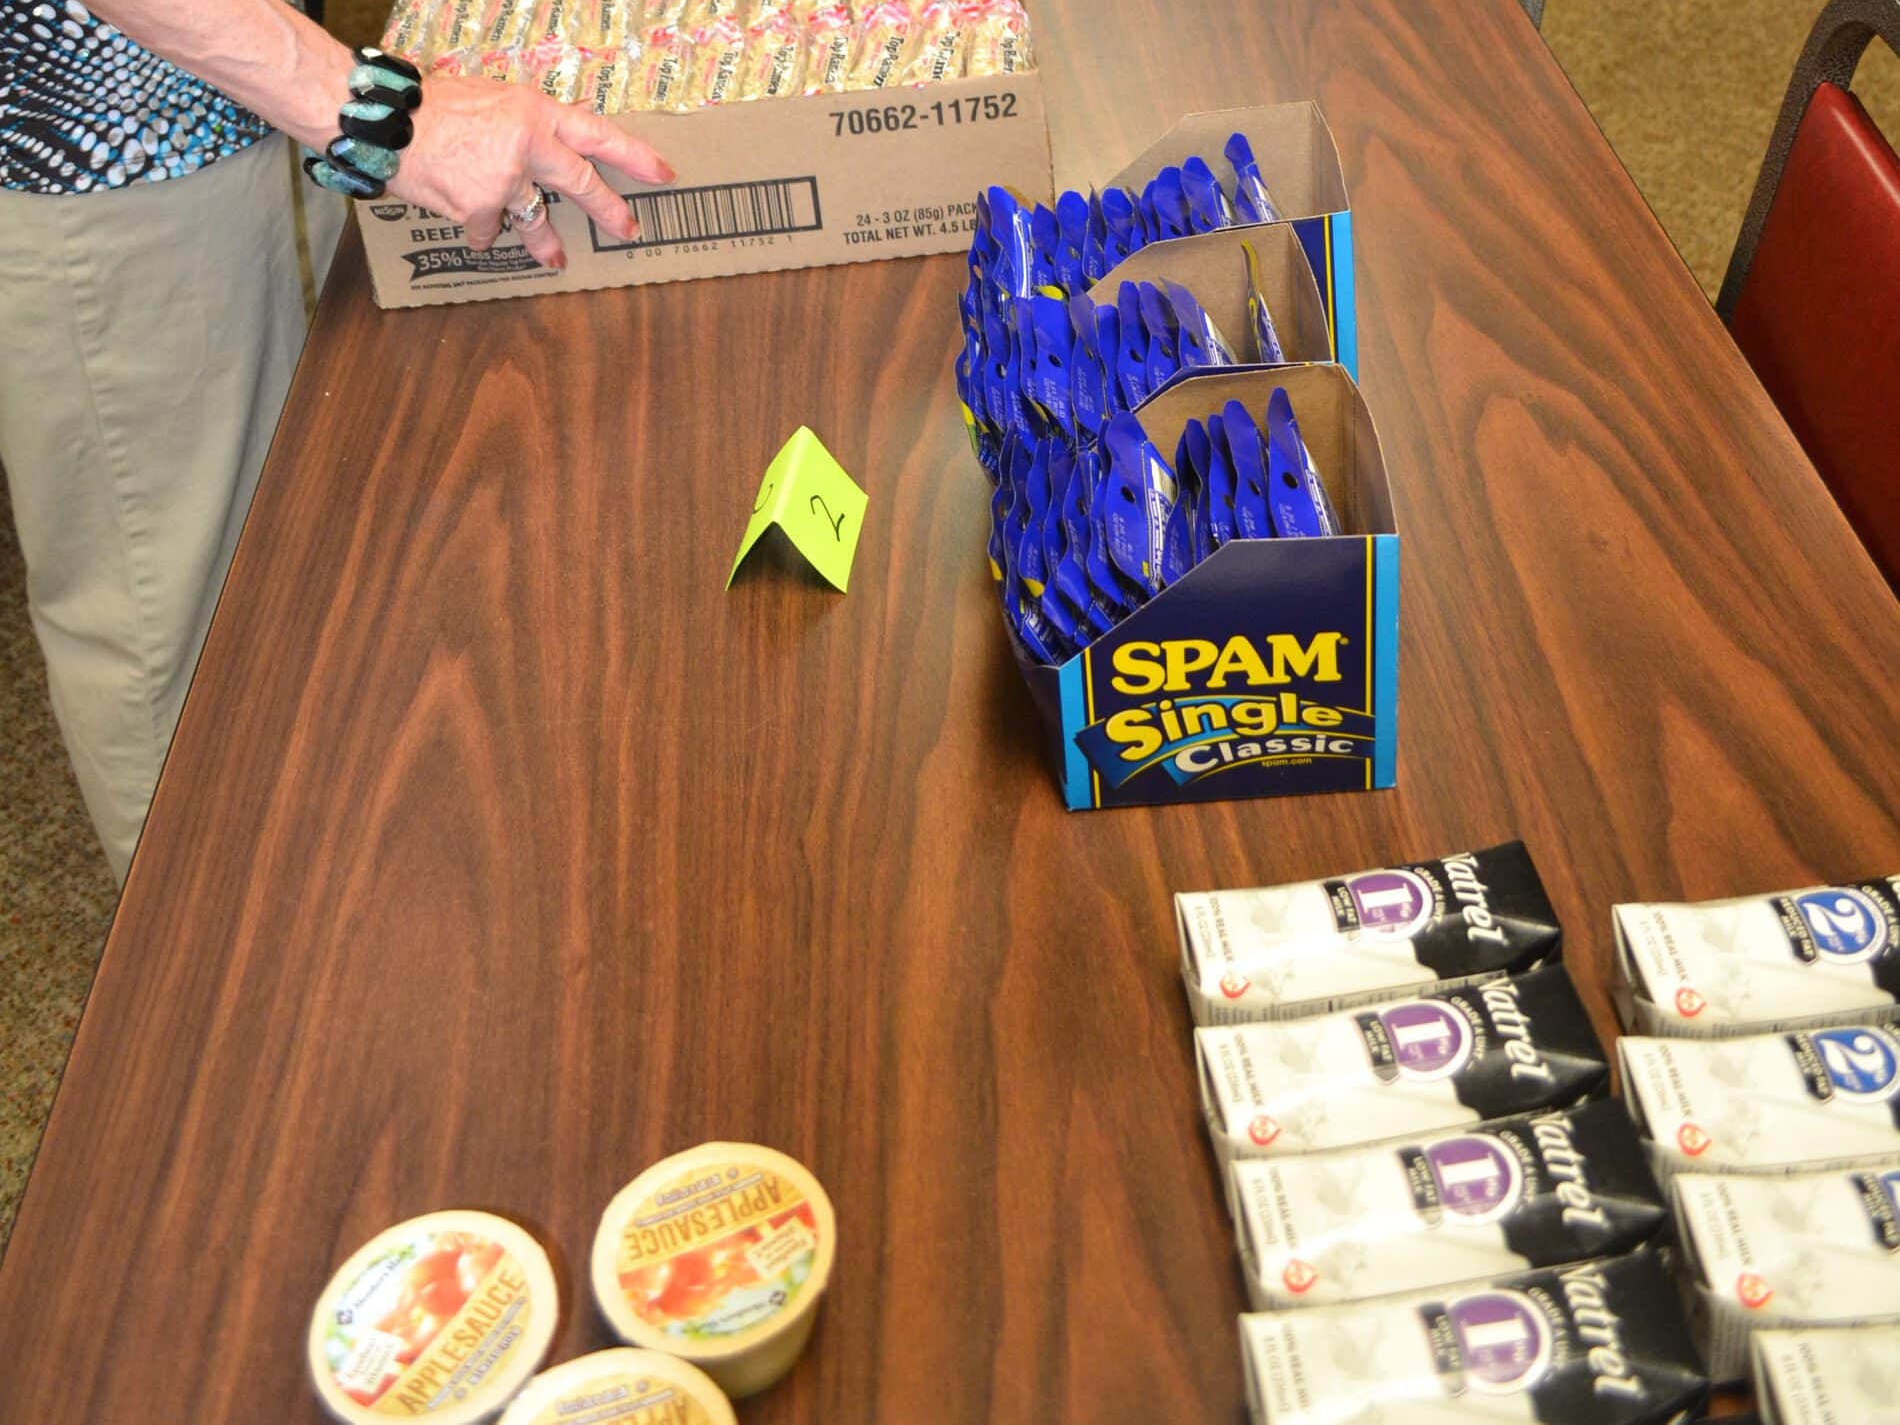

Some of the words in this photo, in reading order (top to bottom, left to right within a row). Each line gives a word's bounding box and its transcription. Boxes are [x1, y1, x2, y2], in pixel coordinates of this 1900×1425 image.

[829, 92, 1018, 137] 70662-11752
[410, 225, 465, 243] BEEF
[843, 229, 882, 245] TOTAL
[886, 226, 909, 241] NET
[913, 223, 936, 238] WT.
[940, 221, 959, 235] 4.5
[856, 213, 871, 227] 24
[883, 212, 890, 224] 3
[894, 209, 911, 224] OZ
[914, 206, 944, 224] (85g)
[417, 251, 462, 271] 35%
[492, 246, 528, 261] Sodiu
[673, 241, 719, 256] 70662
[730, 236, 776, 249] 11752
[1111, 631, 1343, 696] SPAM
[1105, 692, 1345, 762] Single
[1174, 733, 1356, 774] Classic
[1261, 757, 1313, 769] spam.com
[1357, 882, 1415, 915] 1
[1440, 852, 1511, 947] Natrel
[1802, 897, 1866, 937] 2
[1391, 1015, 1453, 1052] 1
[1478, 977, 1556, 1083] Natrel
[1817, 1034, 1886, 1074] 2
[1436, 1152, 1500, 1191] 1
[1528, 1111, 1612, 1232] Natrel
[623, 1175, 785, 1262] APPLESAUCE
[396, 1269, 526, 1415] APPLESAUCE
[1460, 1310, 1530, 1351] 1
[1558, 1263, 1647, 1401] Natrel
